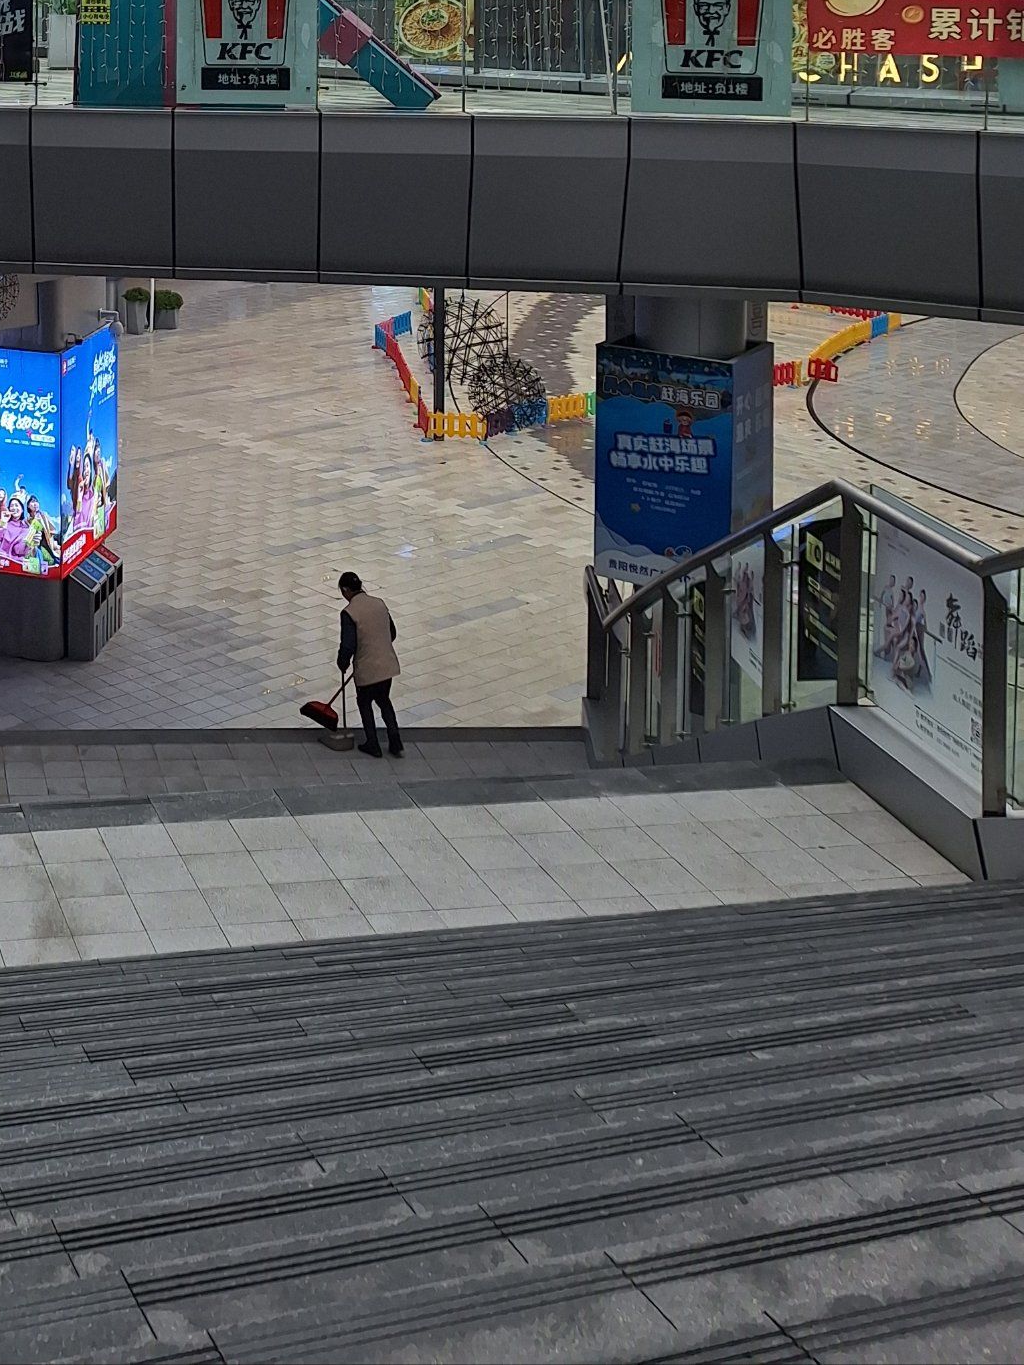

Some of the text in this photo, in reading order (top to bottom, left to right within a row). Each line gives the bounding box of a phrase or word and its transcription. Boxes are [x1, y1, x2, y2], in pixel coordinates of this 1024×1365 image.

[812, 27, 896, 51] 必胜客
[217, 42, 273, 61] KFC
[680, 48, 744, 70] KFC
